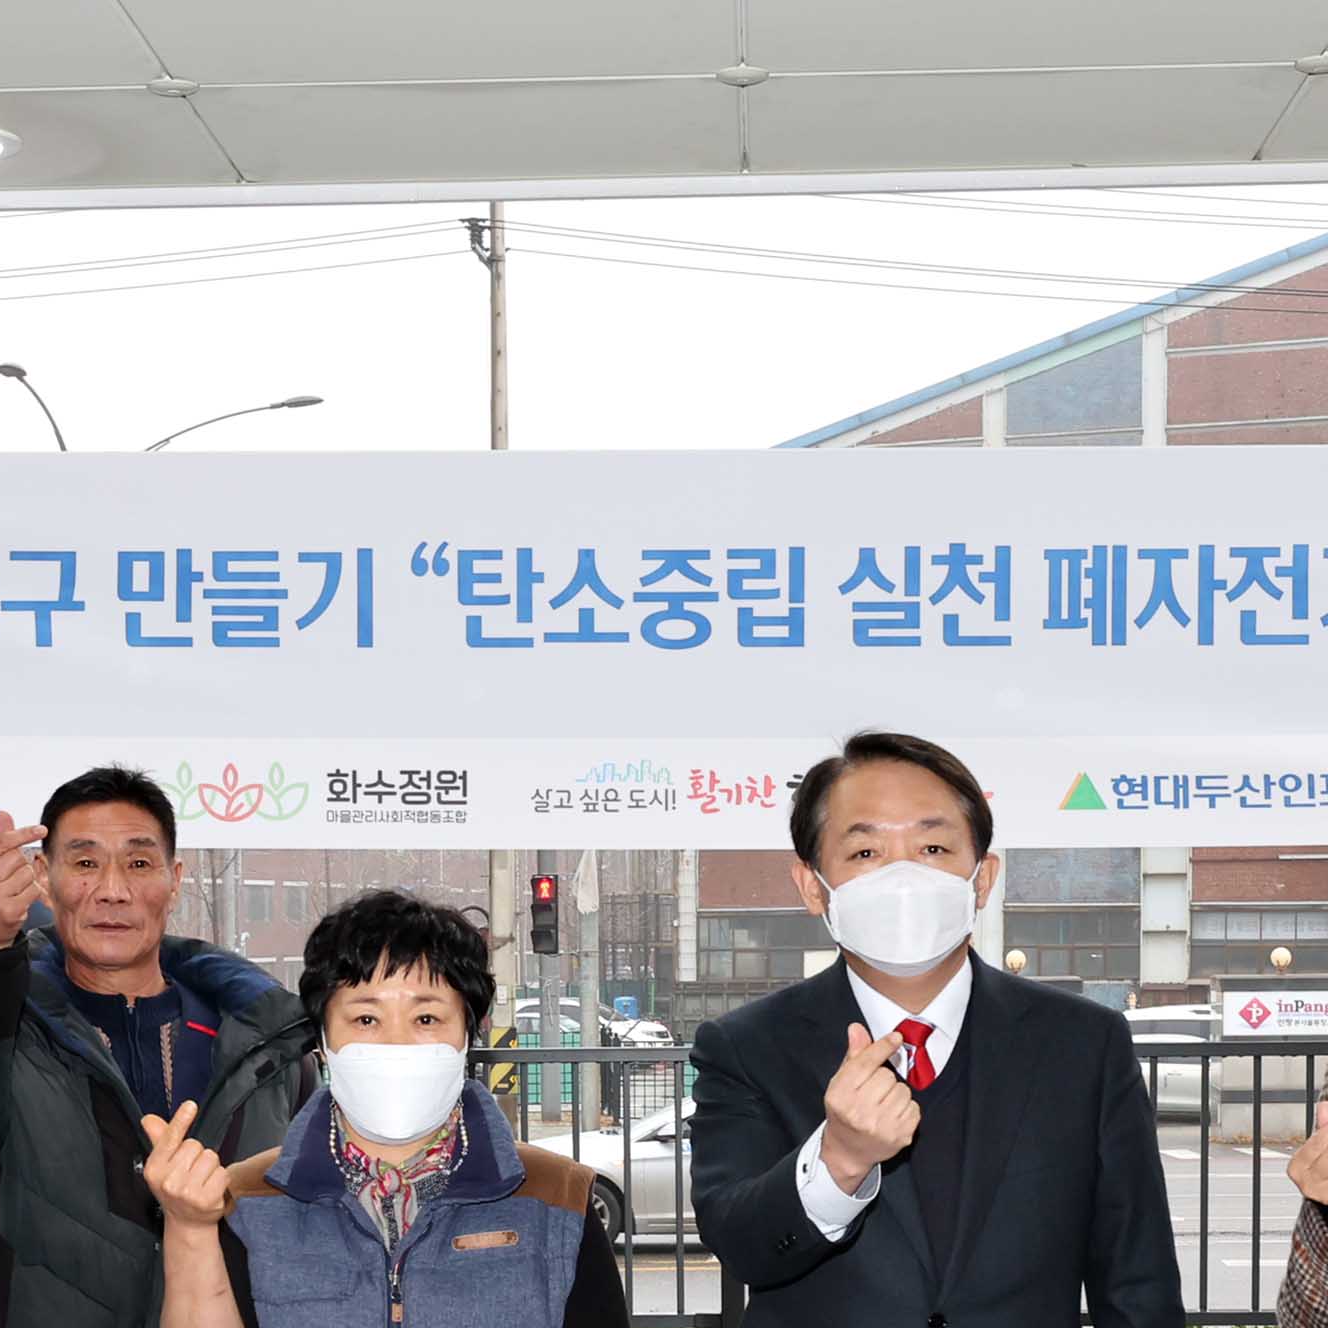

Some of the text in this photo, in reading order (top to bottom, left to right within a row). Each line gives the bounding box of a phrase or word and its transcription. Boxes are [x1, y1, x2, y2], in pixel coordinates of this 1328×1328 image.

[118, 547, 375, 649] 만들기
[411, 541, 806, 650] “탄소중립
[838, 543, 1013, 647] 실천
[326, 769, 468, 806] 화수정원
[531, 788, 676, 813] 살고 싶은 도시!
[687, 768, 777, 814] 활기찬
[326, 809, 467, 824] 마을관리사회적협동조합
